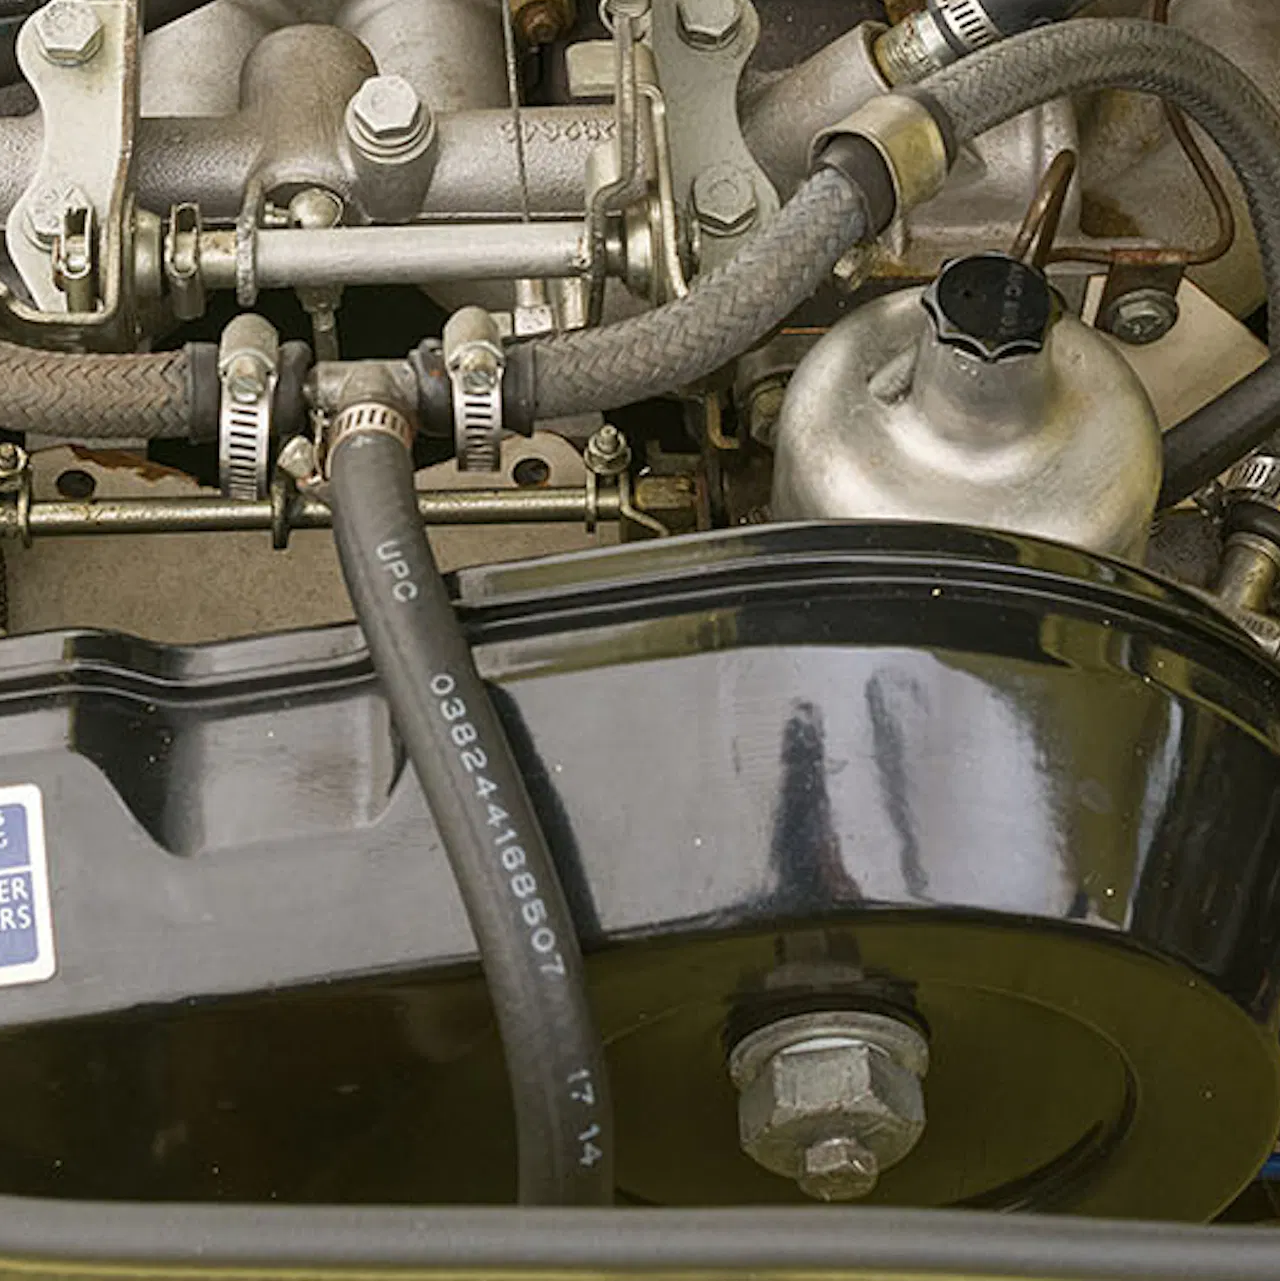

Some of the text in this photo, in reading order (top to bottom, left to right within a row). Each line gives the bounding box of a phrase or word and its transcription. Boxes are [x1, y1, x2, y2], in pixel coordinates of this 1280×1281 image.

[375, 539, 418, 603] UPC
[429, 673, 566, 979] 038244168507
[579, 1123, 602, 1167] 14
